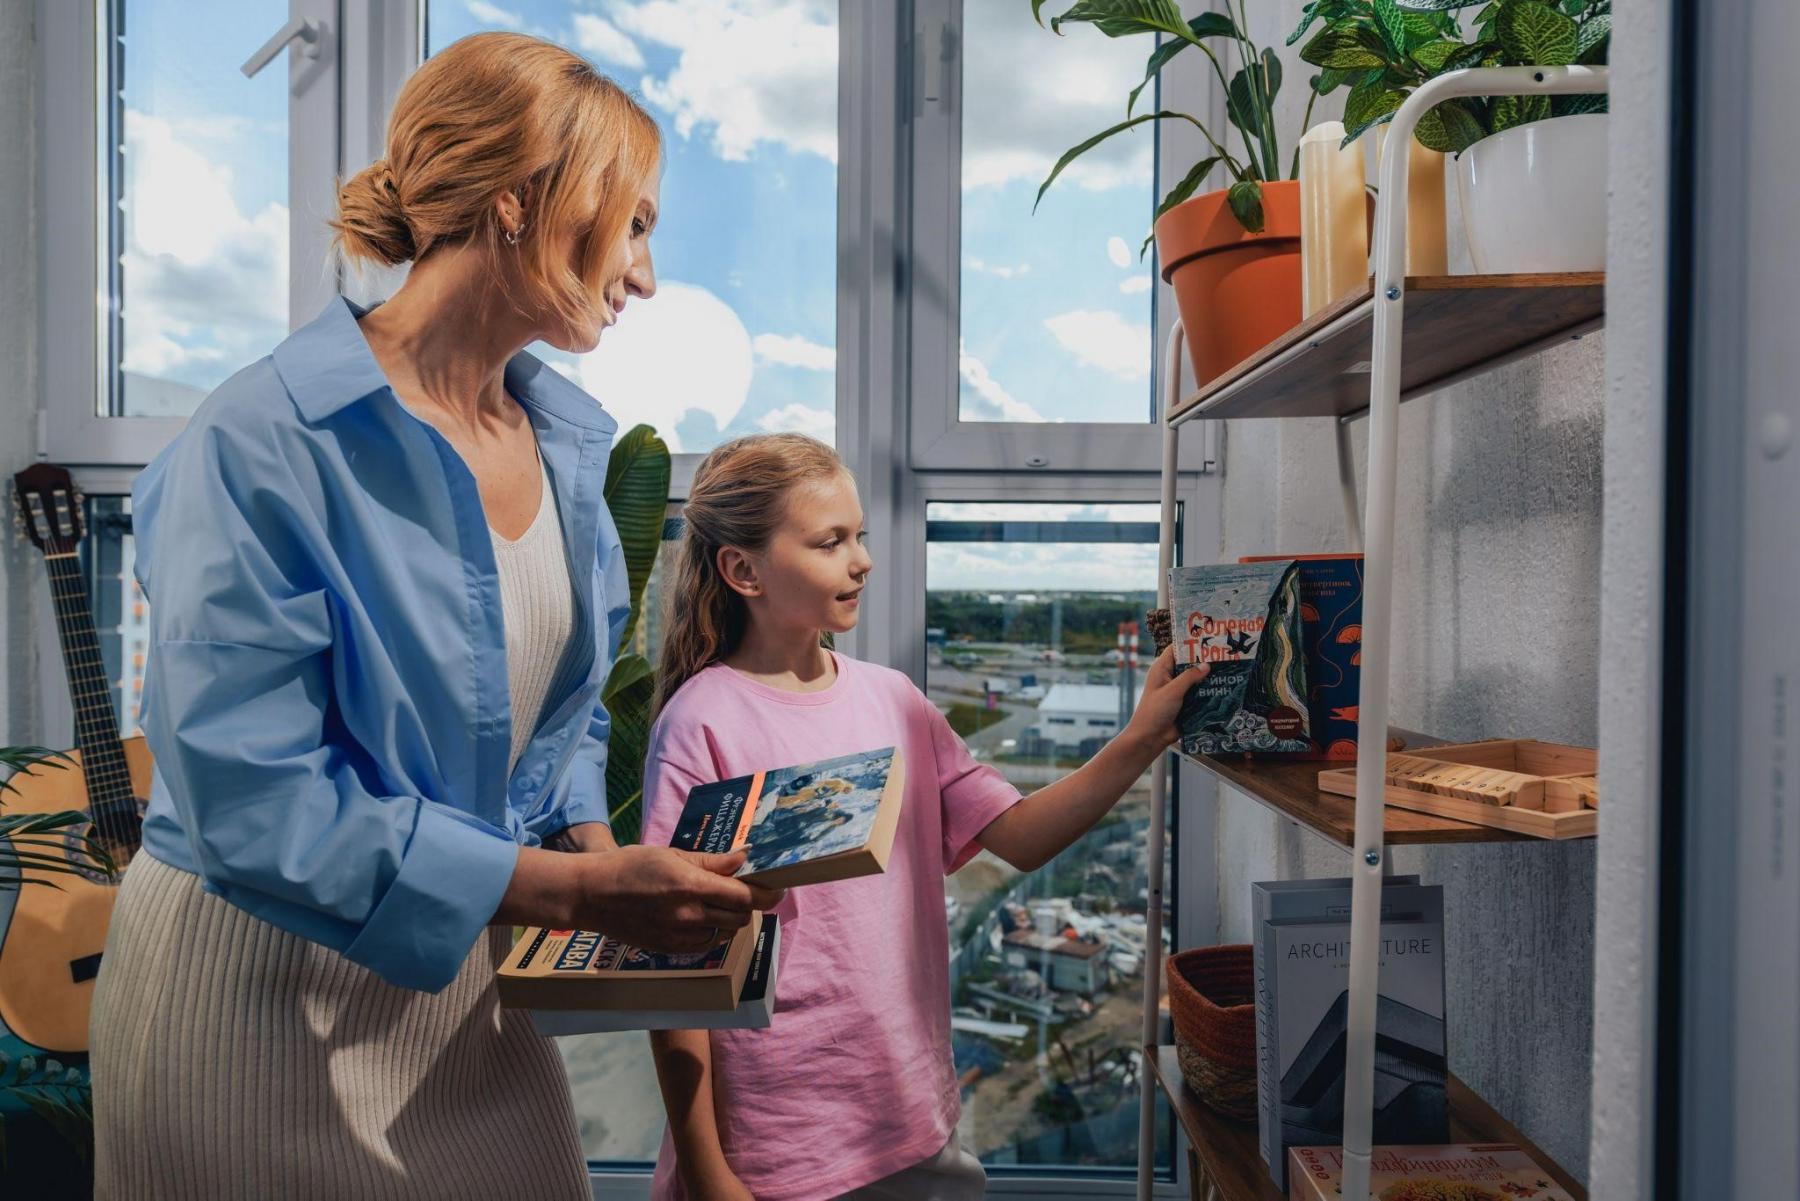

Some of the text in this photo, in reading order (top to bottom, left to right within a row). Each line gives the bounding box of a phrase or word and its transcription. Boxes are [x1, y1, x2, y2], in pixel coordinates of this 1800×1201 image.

[1188, 611, 1265, 637] Соленая
[1198, 687, 1232, 697] ВИНН
[1209, 674, 1244, 685] ЙНОР
[724, 796, 743, 833] Фрэнсис
[560, 929, 600, 969] АГАВА
[592, 938, 621, 969] ОСКЭ
[1288, 938, 1432, 960] ARCHITURE
